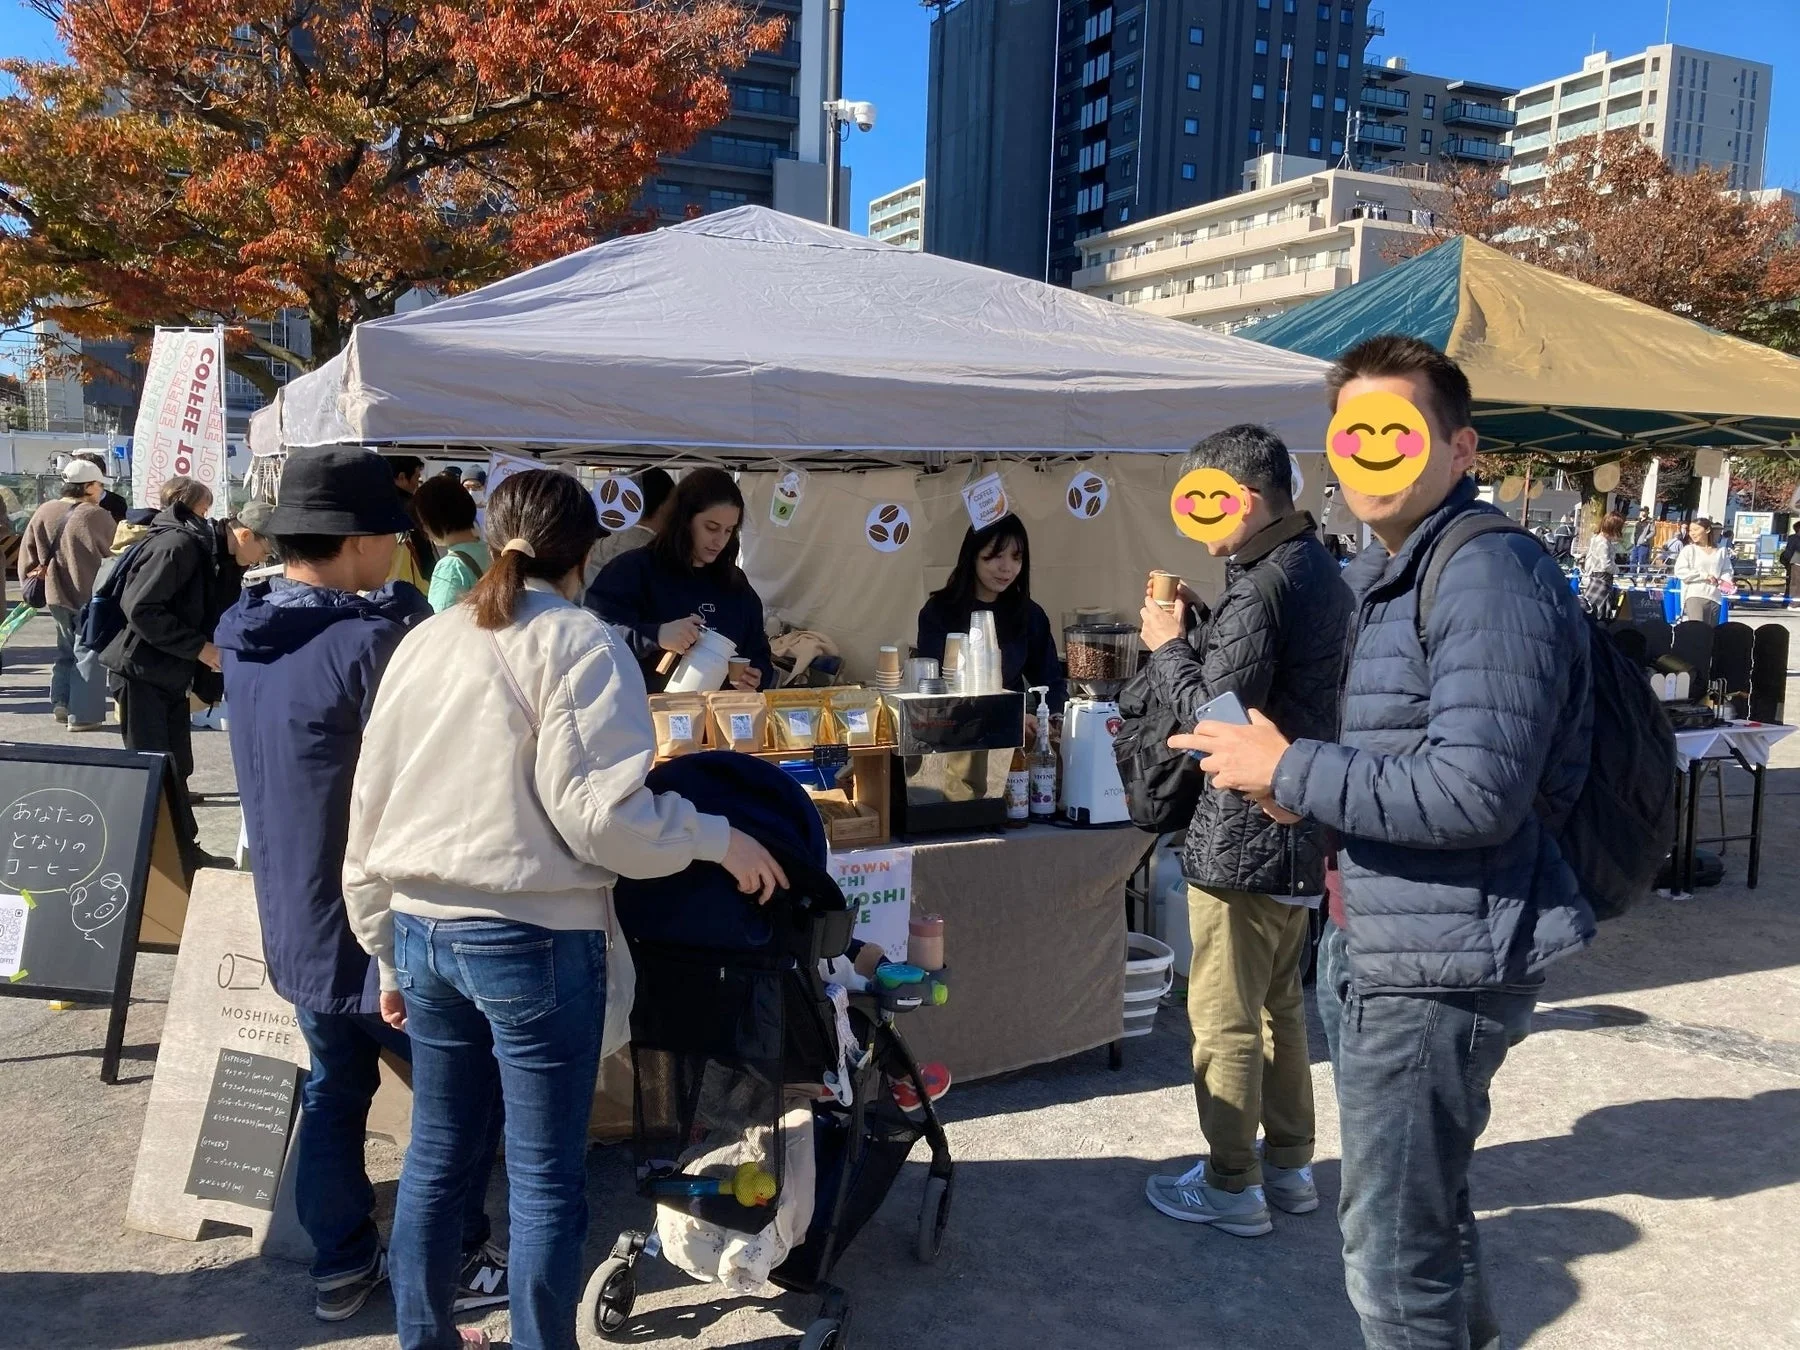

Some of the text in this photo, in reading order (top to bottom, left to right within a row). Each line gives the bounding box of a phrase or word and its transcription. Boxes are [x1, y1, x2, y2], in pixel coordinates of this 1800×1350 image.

[13, 803, 94, 826] あなたの
[12, 831, 86, 853] となりの
[7, 859, 80, 875] コーヒー
[840, 861, 890, 875] TOWN
[221, 1006, 298, 1028] MOSHIMOS
[238, 1027, 291, 1045] COFFEE
[1181, 1189, 1204, 1207] N
[468, 1266, 505, 1294] N
